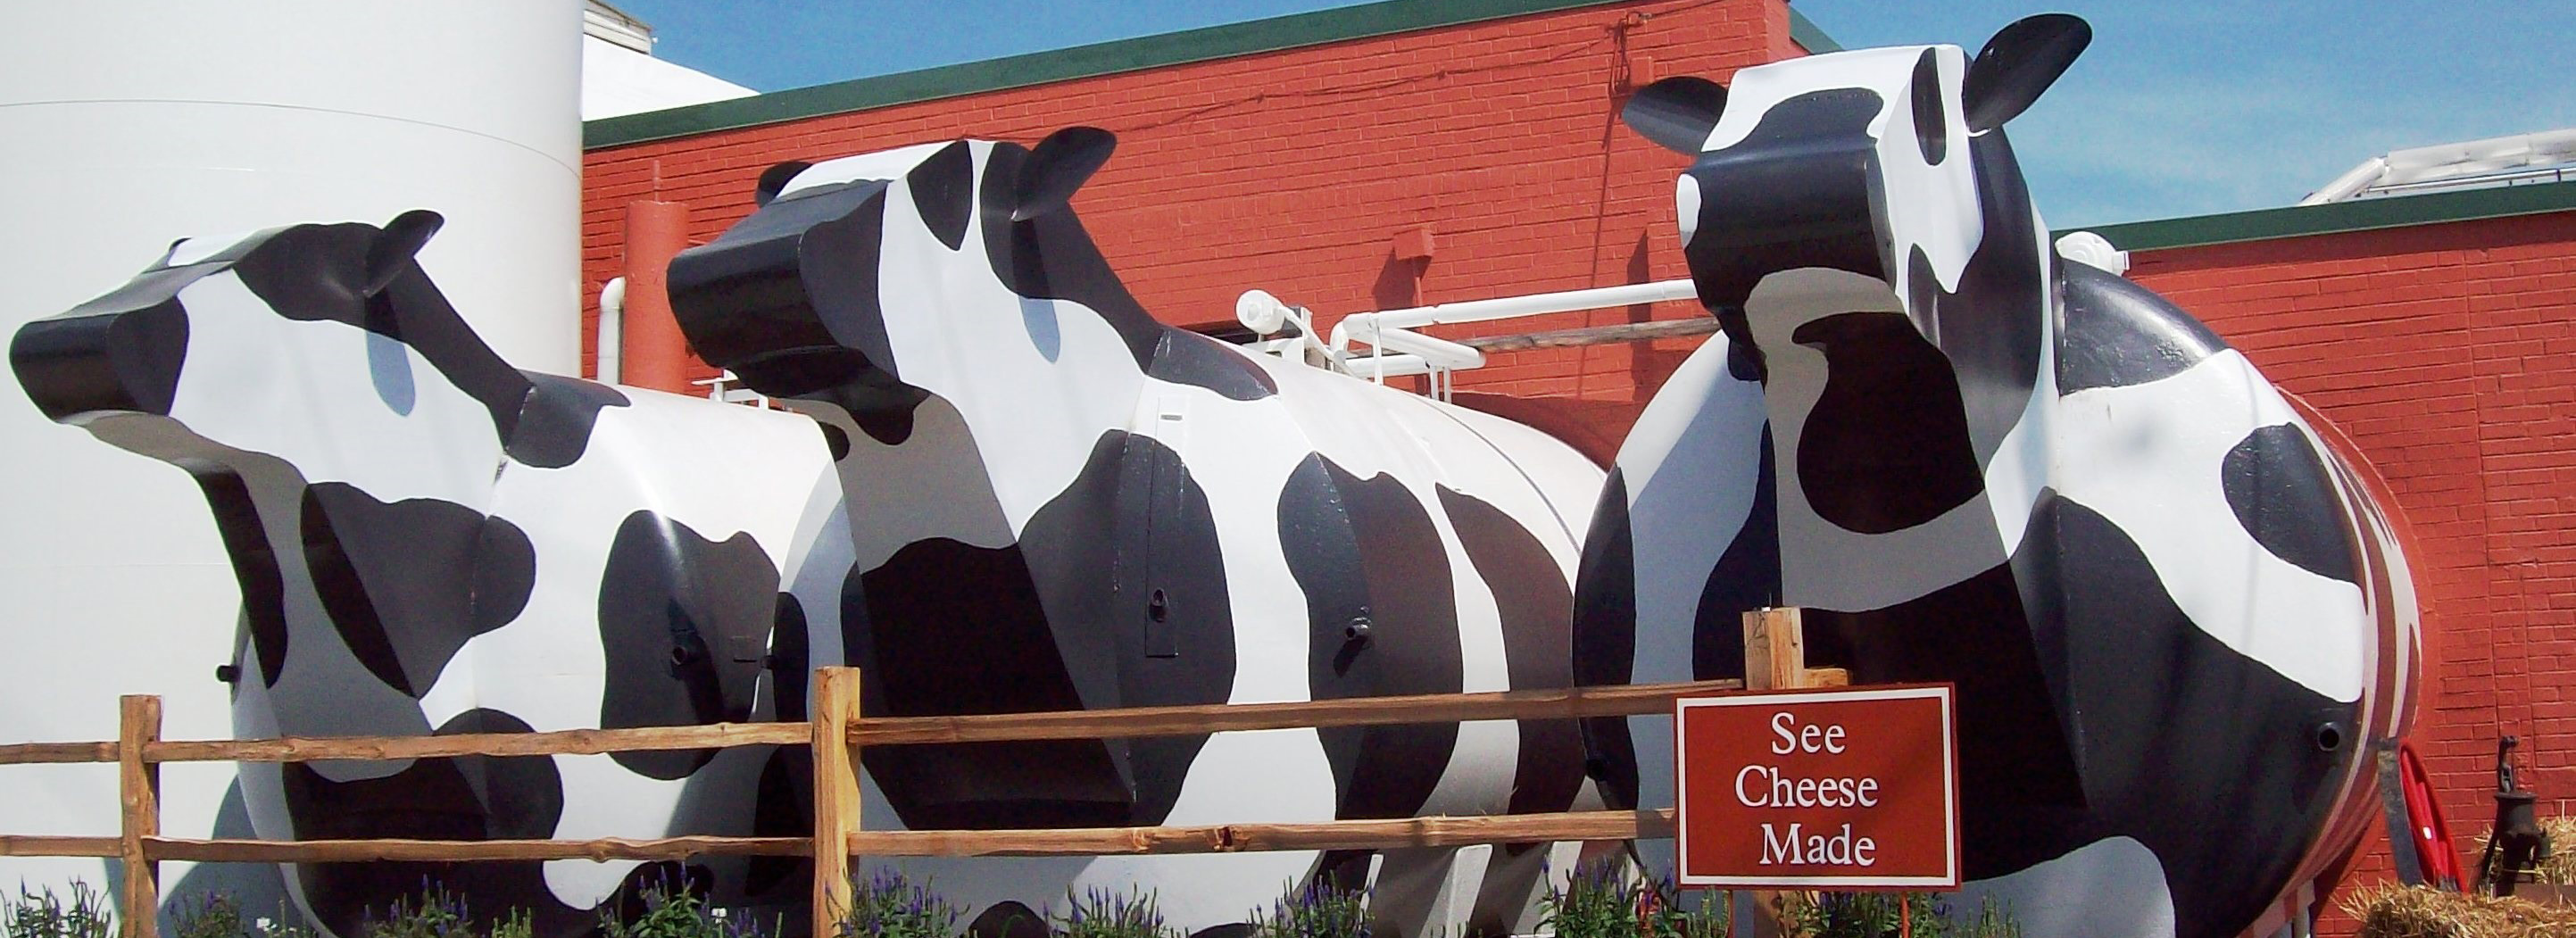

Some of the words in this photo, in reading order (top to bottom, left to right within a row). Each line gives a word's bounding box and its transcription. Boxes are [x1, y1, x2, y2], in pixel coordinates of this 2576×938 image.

[1772, 712, 1846, 754] See
[1735, 765, 1879, 808] Cheese
[1759, 823, 1876, 867] Made
